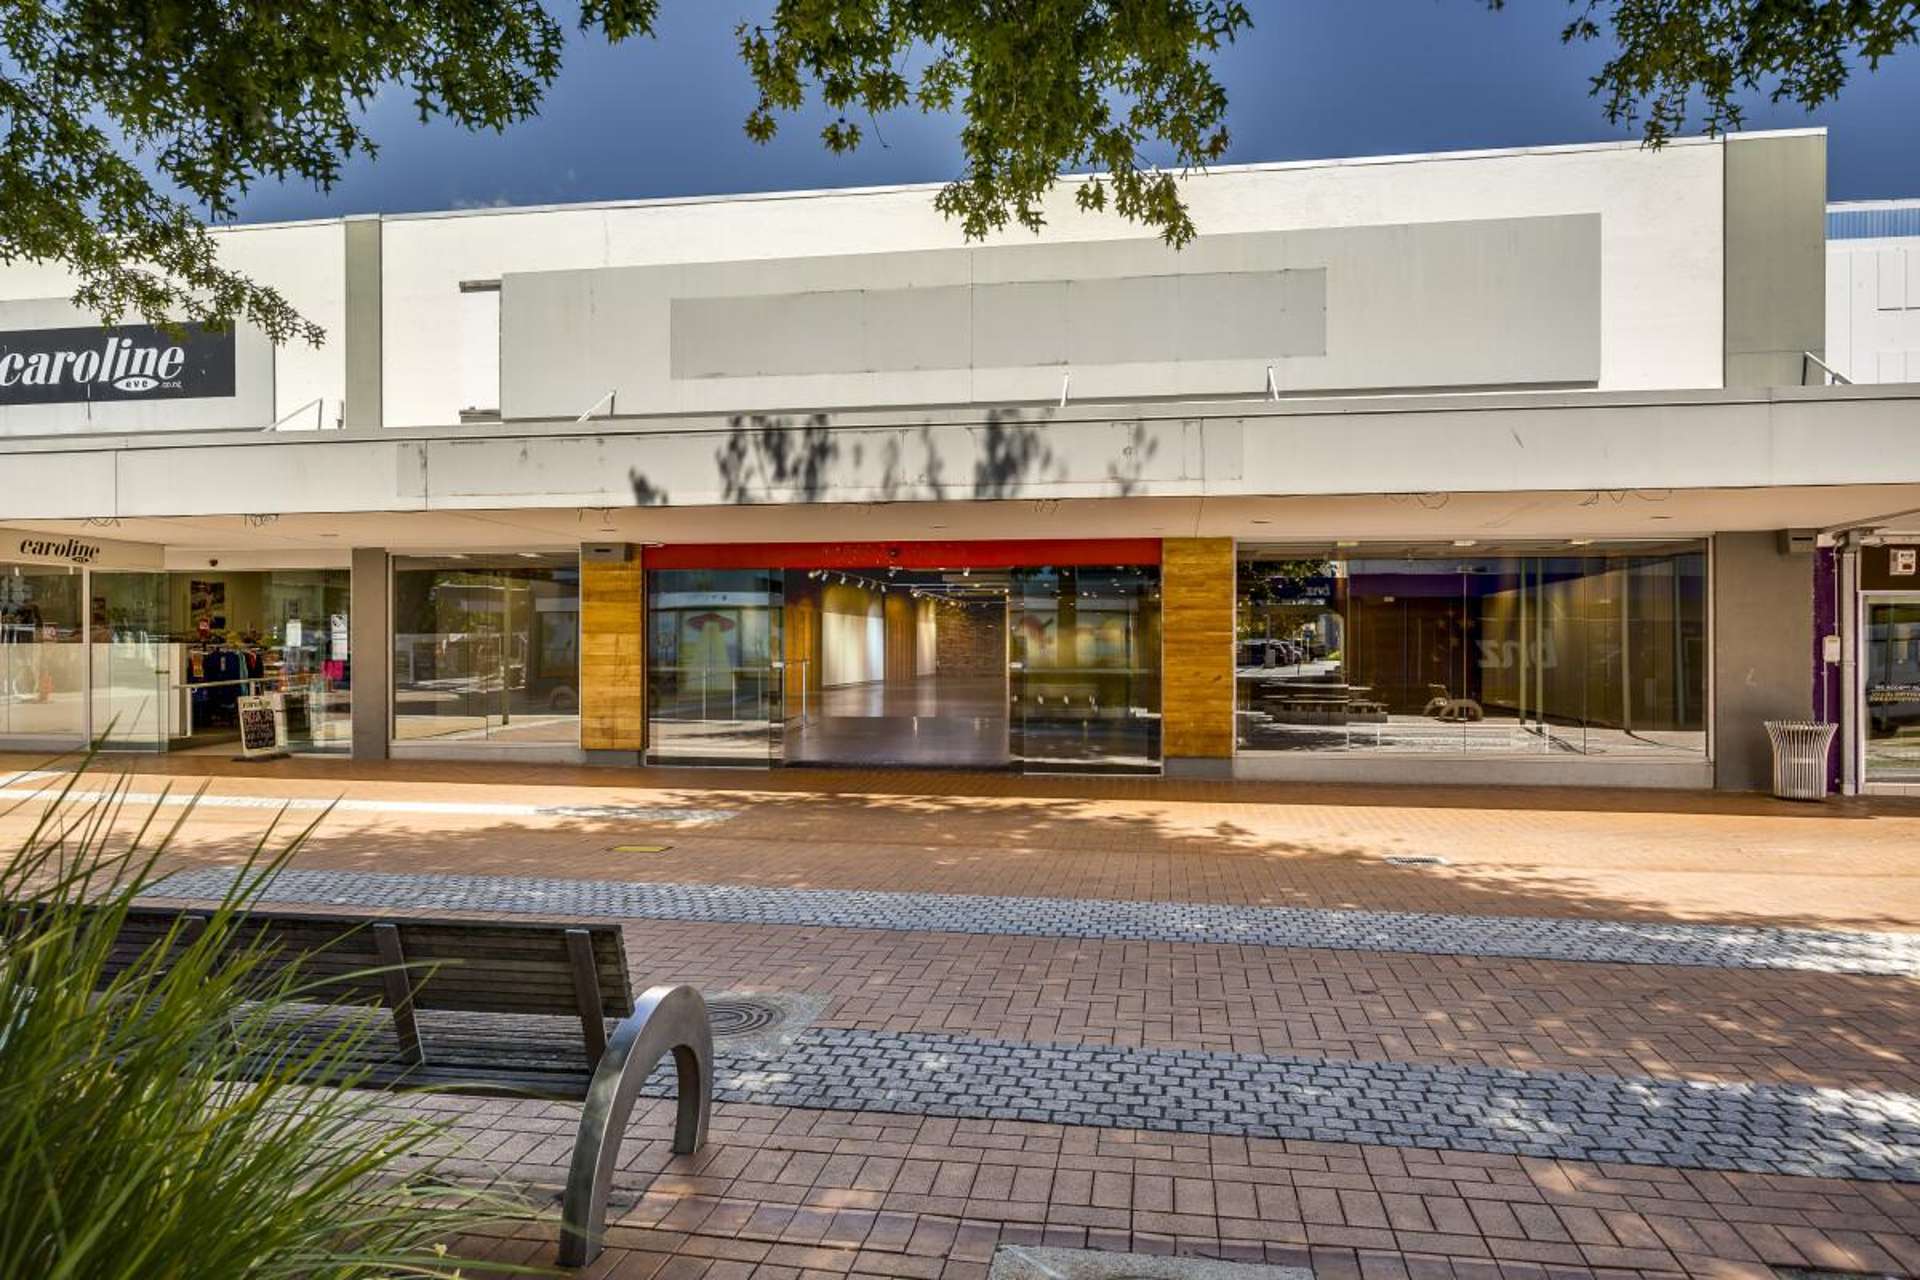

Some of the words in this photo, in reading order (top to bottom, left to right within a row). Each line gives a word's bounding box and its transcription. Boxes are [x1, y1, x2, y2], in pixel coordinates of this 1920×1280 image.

[0, 337, 185, 386] caroline
[125, 381, 149, 389] eve
[20, 539, 100, 559] caroline
